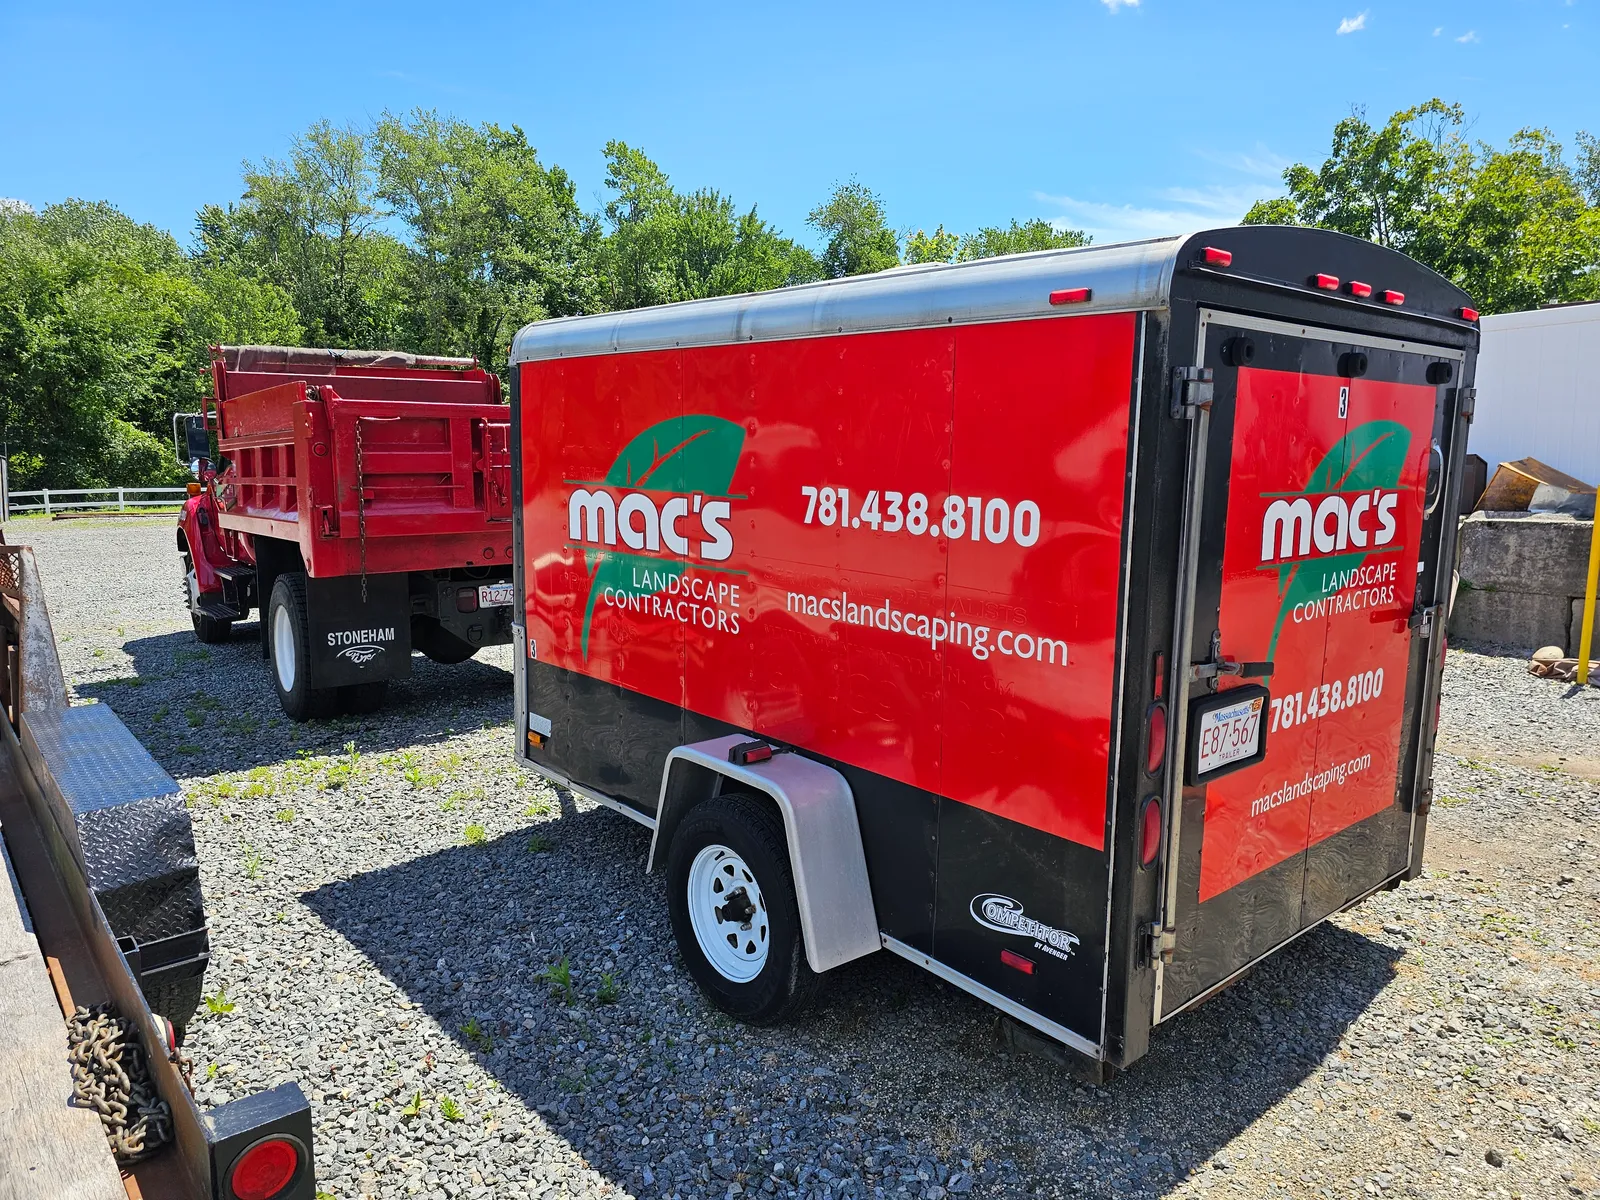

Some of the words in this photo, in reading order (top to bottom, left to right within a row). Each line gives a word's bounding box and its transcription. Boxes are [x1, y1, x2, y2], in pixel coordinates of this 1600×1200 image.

[1339, 388, 1348, 417] 3
[801, 485, 1041, 548] 781.438.8100
[632, 567, 741, 608] LANDSCAPE
[1321, 562, 1397, 594] LANDSCAPE
[603, 586, 741, 635] CONTRACTORS
[1293, 585, 1395, 624] CONTRACTORS
[327, 627, 395, 646] STONEHAM
[786, 591, 1069, 667] macslandscaping.com
[1270, 667, 1384, 733] 781.438.8100
[1219, 748, 1240, 760] TRAILER
[1251, 753, 1371, 818] macslandscaping.com
[969, 892, 1080, 954] COMPETITOR
[1042, 944, 1069, 961] AVENGER
